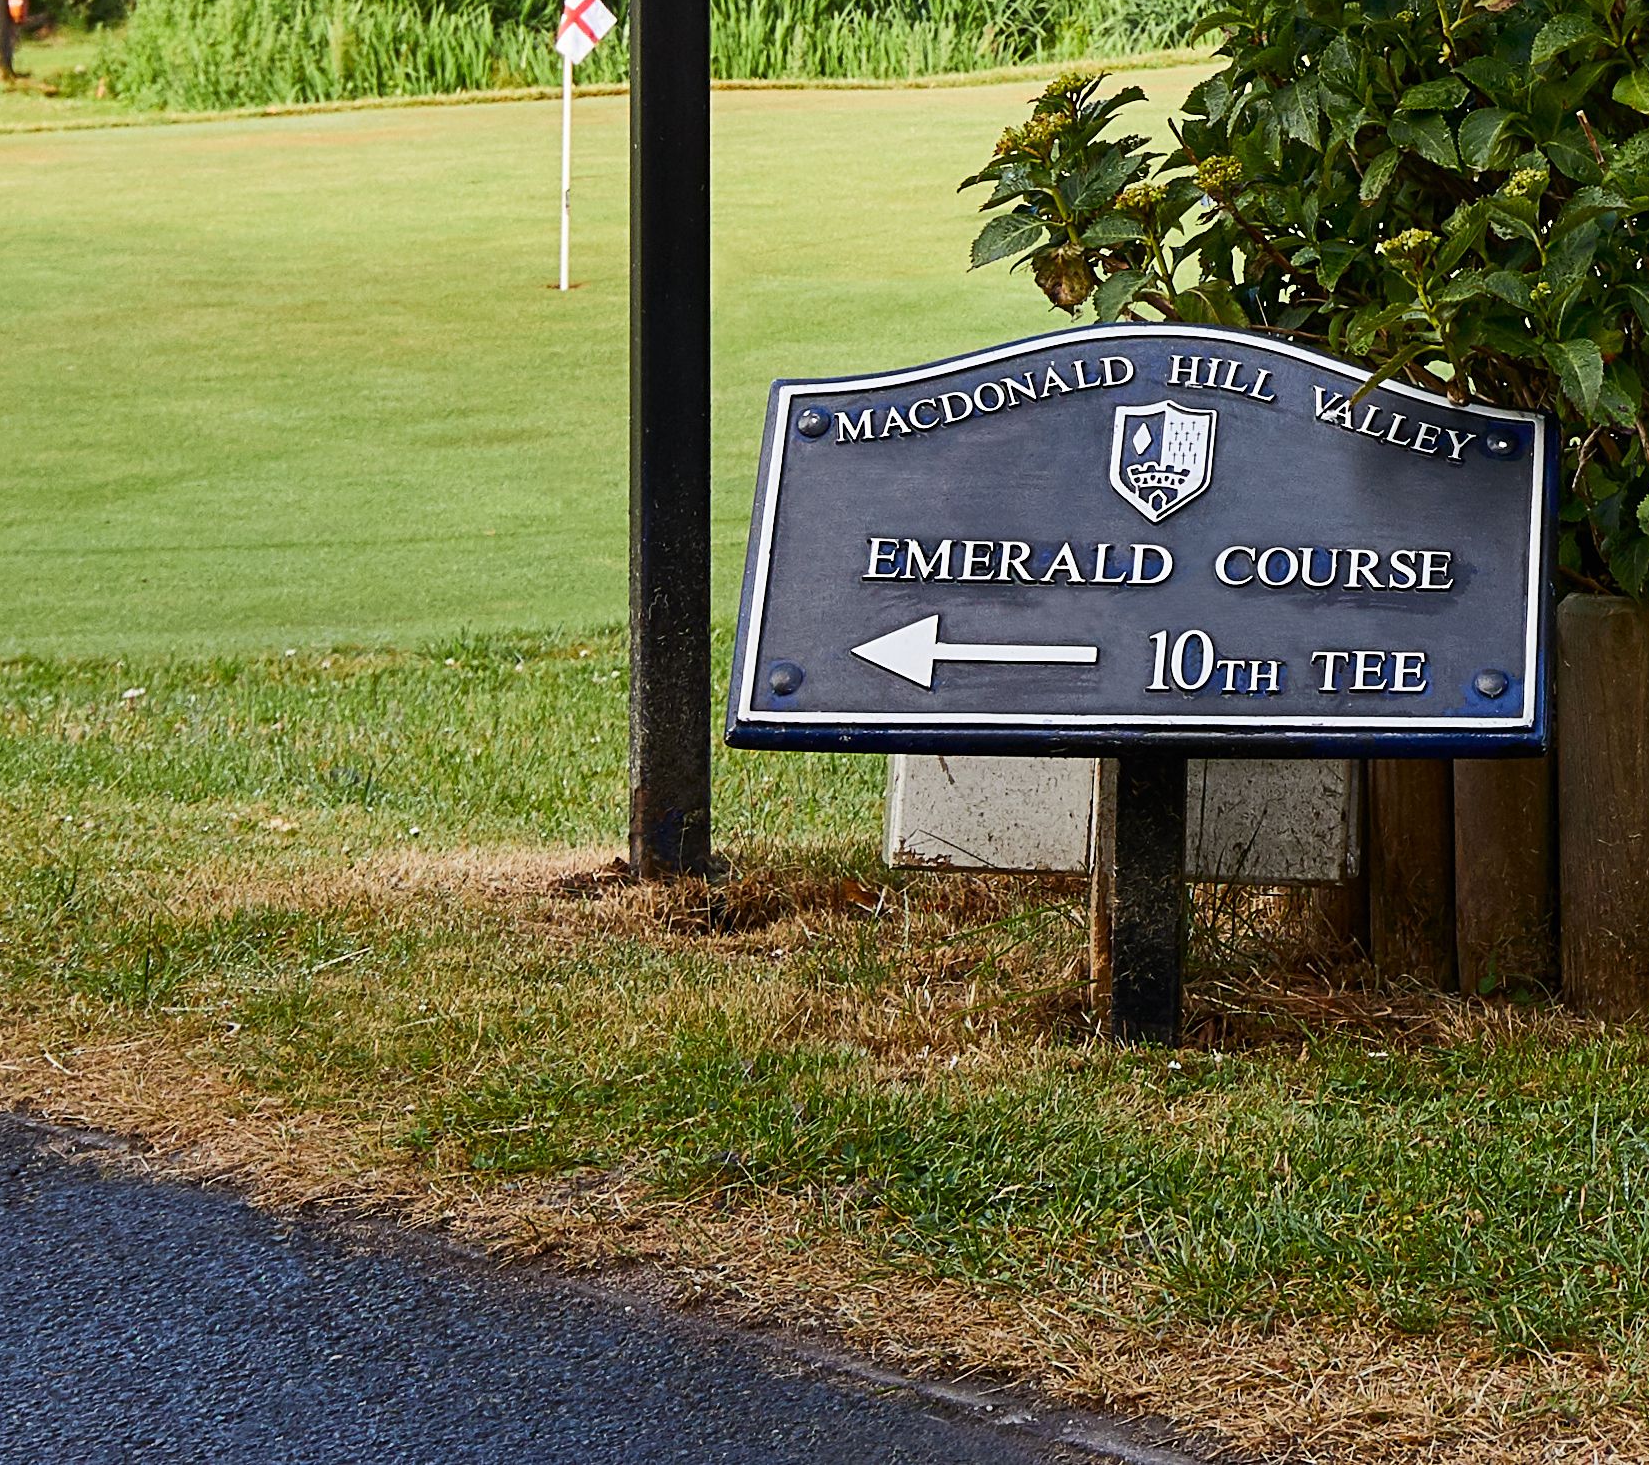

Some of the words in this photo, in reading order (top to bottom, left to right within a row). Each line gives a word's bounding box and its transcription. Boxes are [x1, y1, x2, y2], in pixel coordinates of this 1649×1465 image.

[834, 357, 1133, 441] MACDONALD
[1168, 355, 1274, 401] HILL
[1314, 385, 1476, 459] VALLEY
[863, 538, 1172, 583] EMERALD
[1216, 546, 1453, 588] COURSE
[1146, 630, 1279, 690] 10TH
[1311, 651, 1426, 691] TEE
